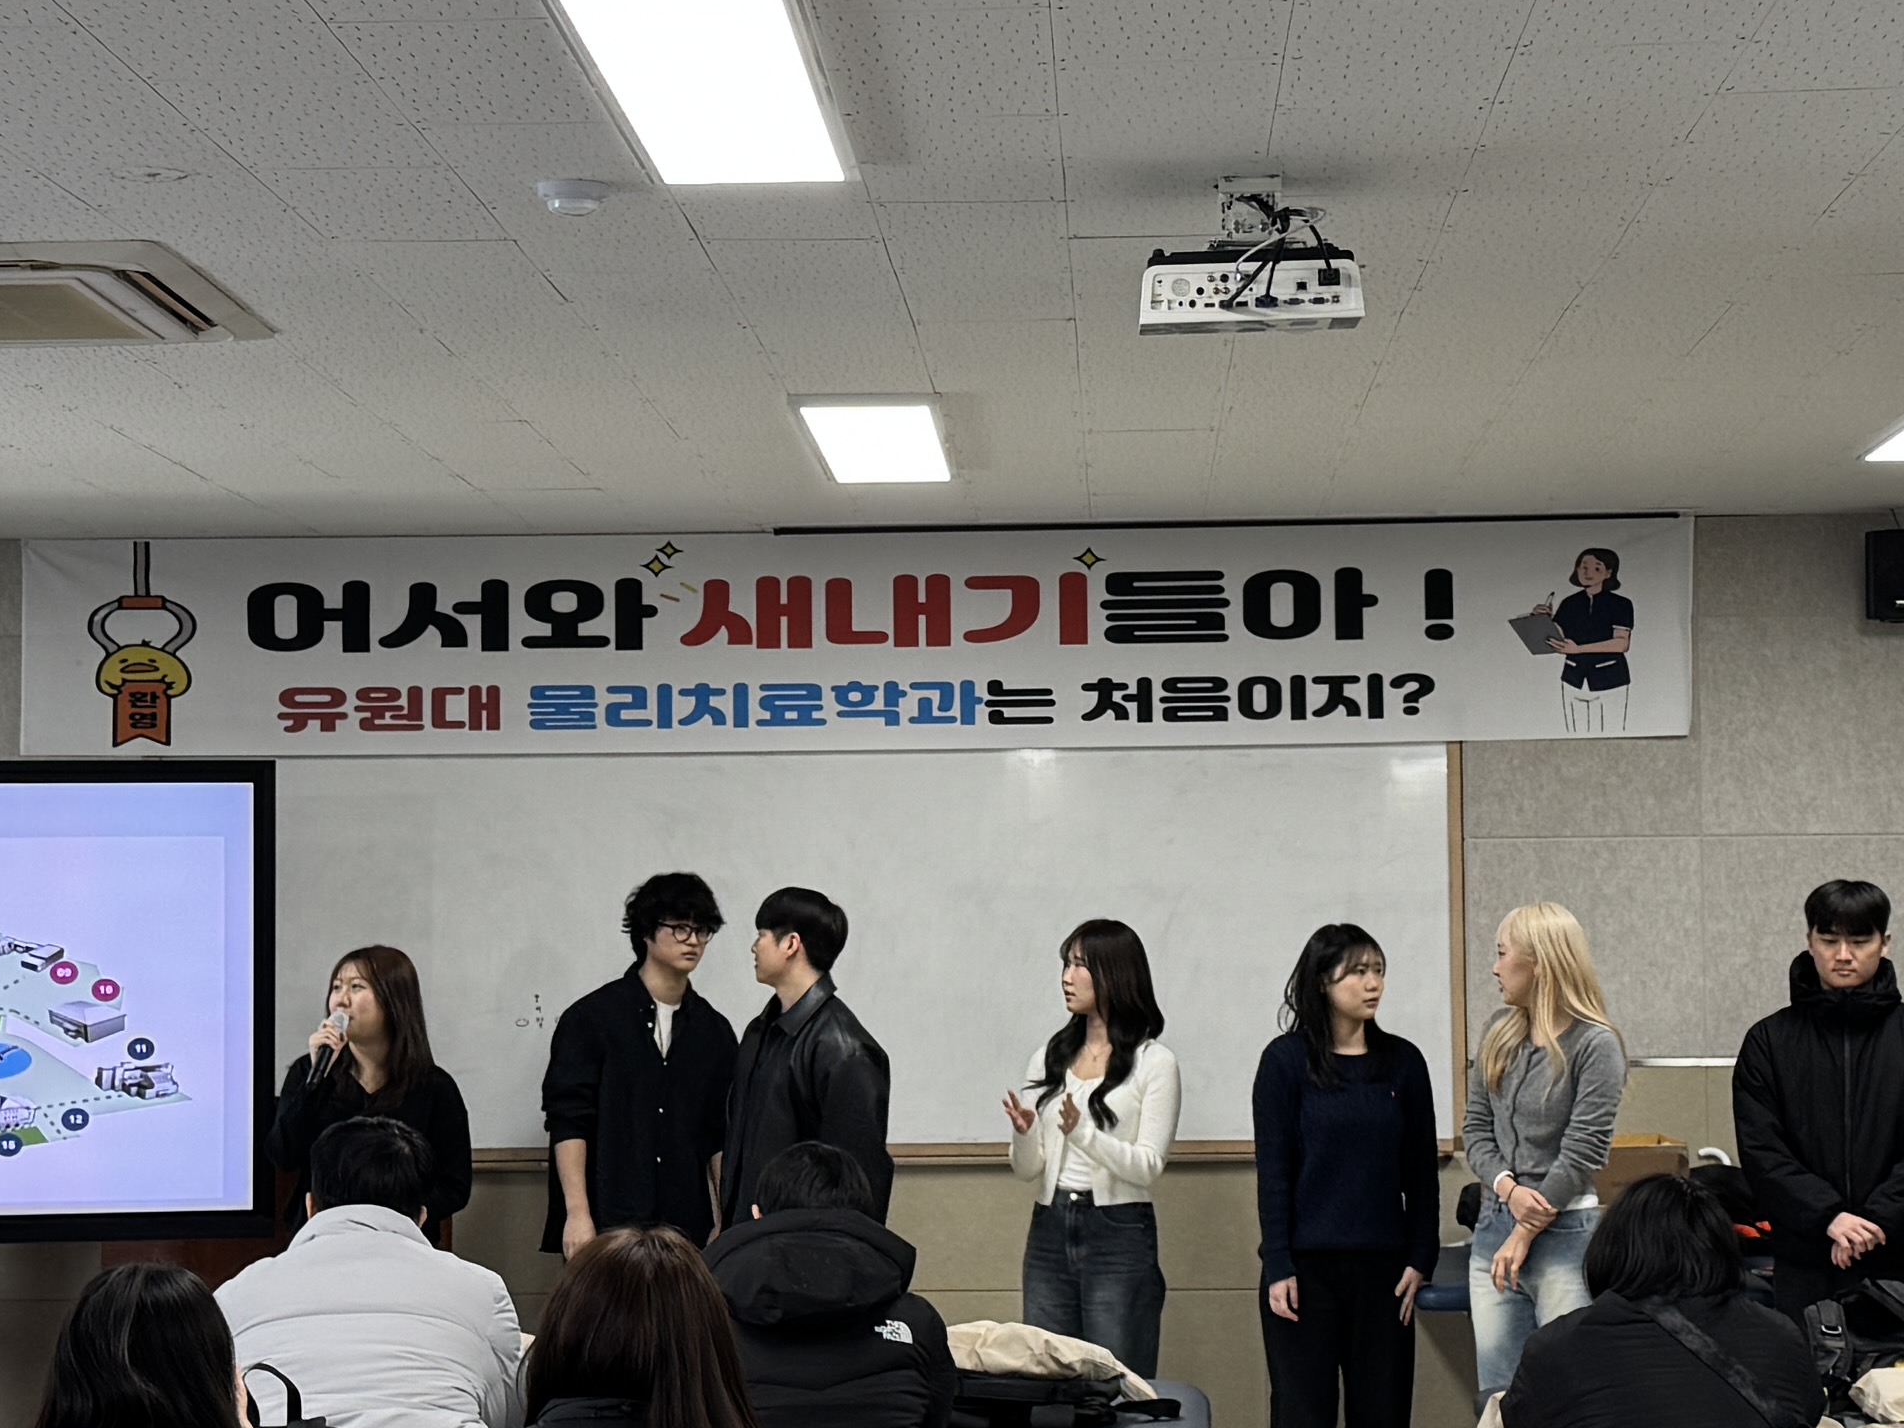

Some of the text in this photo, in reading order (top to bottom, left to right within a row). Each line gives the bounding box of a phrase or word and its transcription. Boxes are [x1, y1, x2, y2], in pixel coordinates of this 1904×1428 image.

[246, 577, 659, 653] 어서와
[679, 566, 1379, 649] 새내기들아
[128, 691, 160, 729] 환영
[277, 672, 1436, 733] 유원대 물리치료학과는 처음이지?
